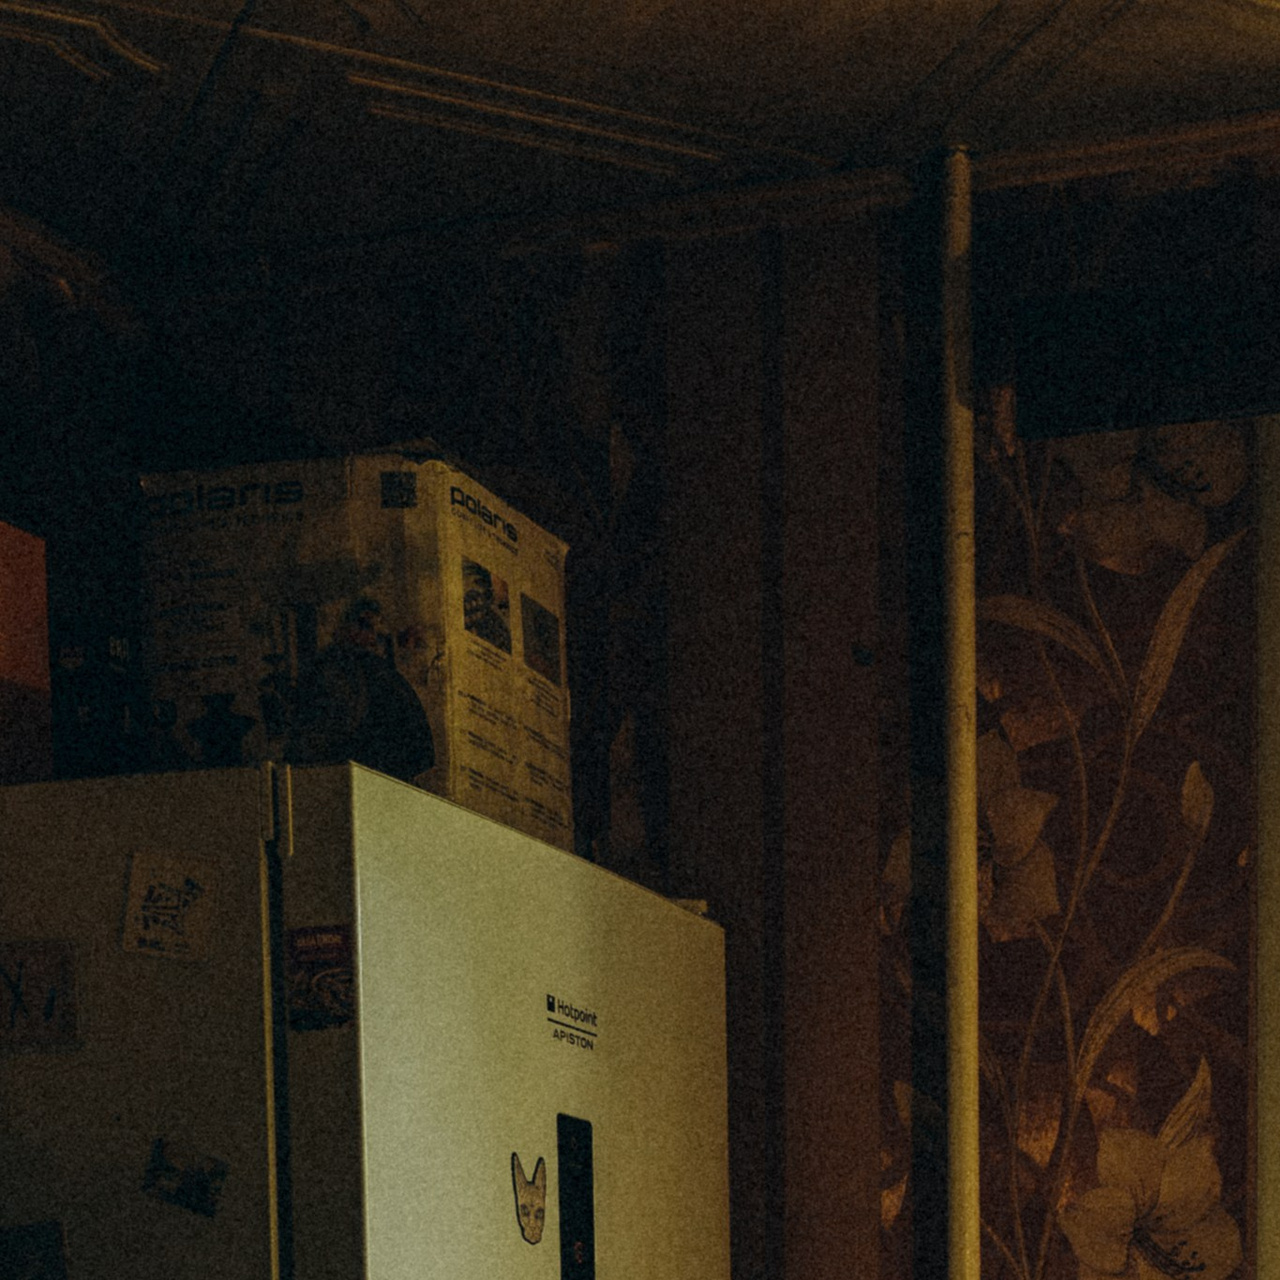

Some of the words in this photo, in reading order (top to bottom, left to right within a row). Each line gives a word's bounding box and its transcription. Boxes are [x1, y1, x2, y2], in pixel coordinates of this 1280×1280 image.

[145, 480, 304, 517] polaris
[450, 486, 518, 542] polaris
[557, 999, 598, 1026] Hotpoint
